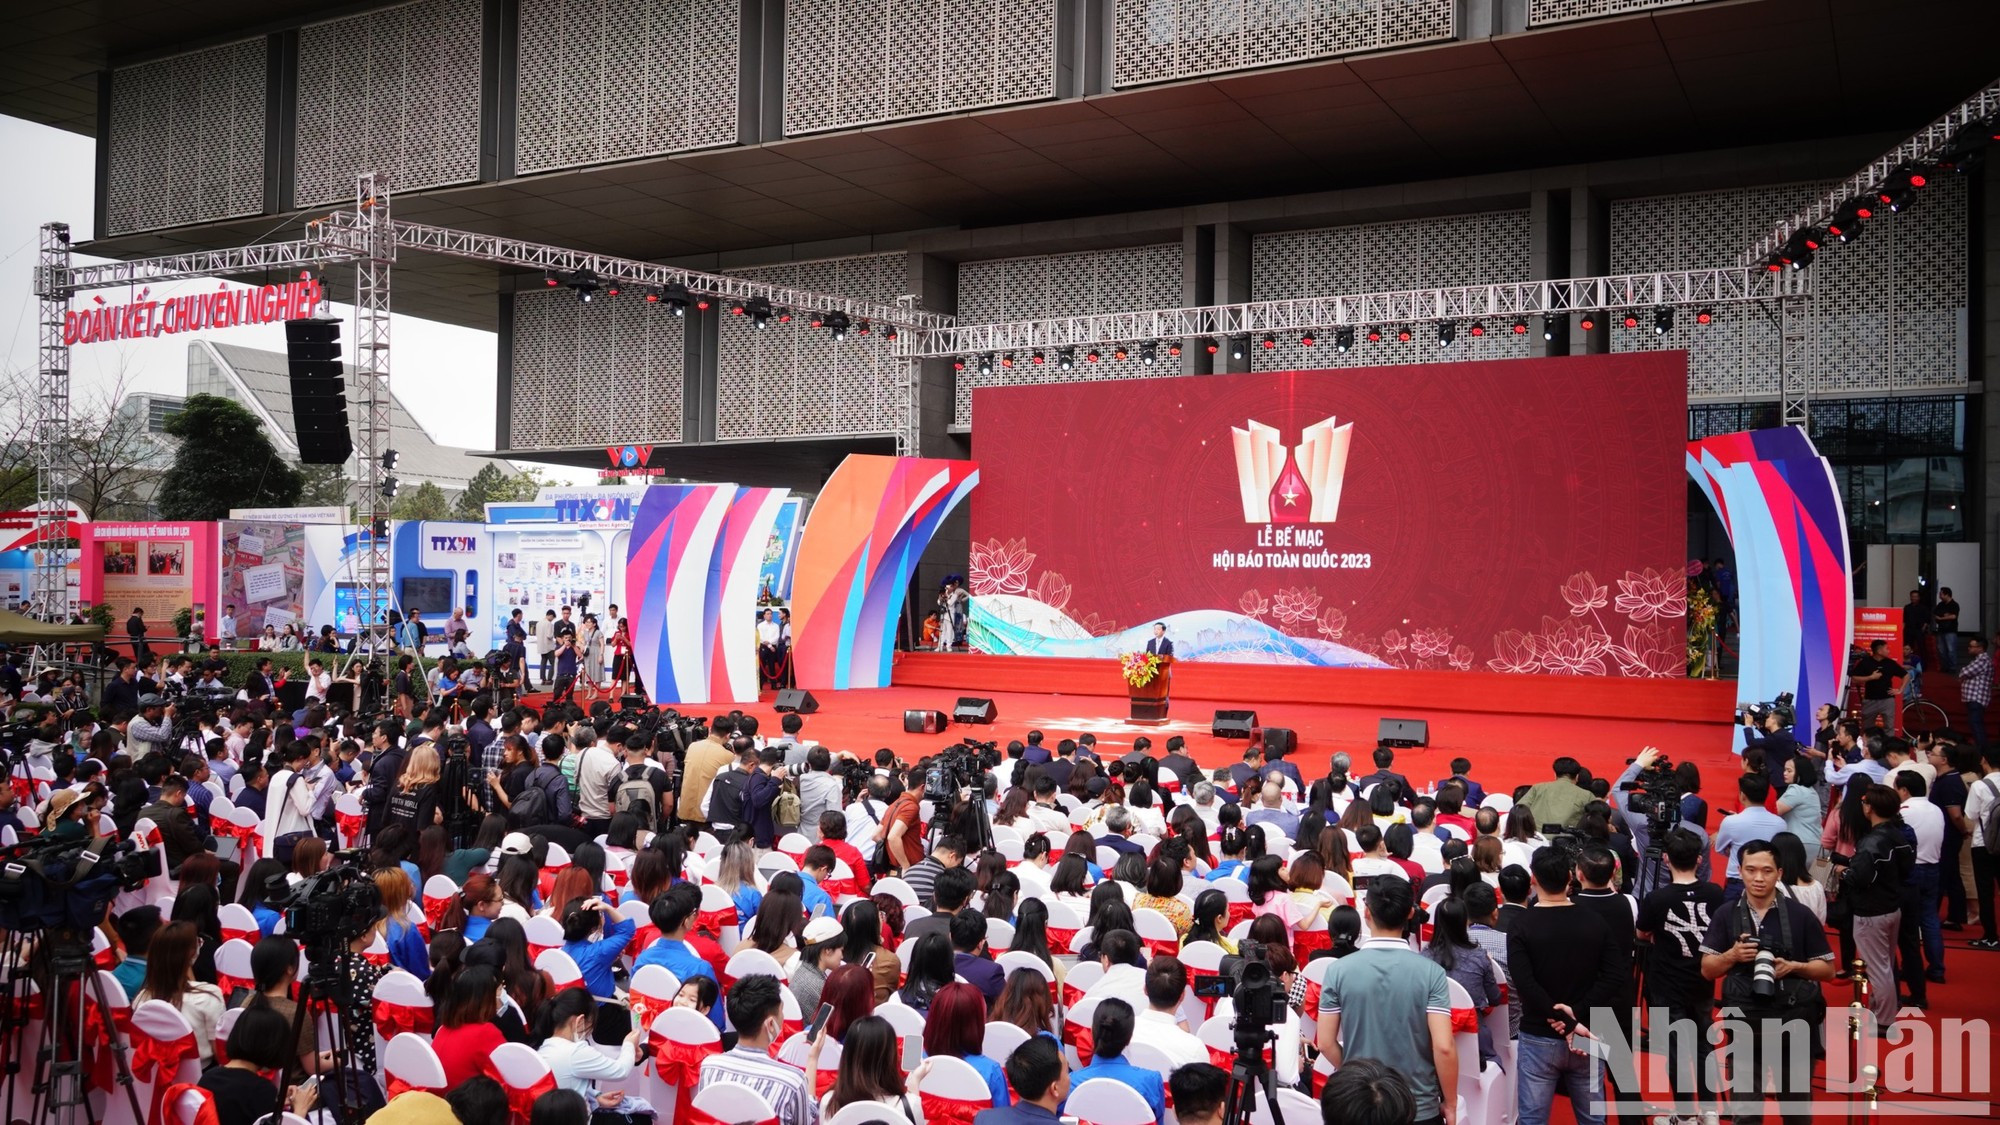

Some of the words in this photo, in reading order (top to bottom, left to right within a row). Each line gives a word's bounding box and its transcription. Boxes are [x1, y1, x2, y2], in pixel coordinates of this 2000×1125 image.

[64, 295, 119, 346] ĐOÀN
[163, 282, 242, 334] CHUYÊN
[607, 444, 654, 467] VOV
[648, 468, 666, 476] NAM
[555, 498, 631, 523] TTXVN
[431, 536, 476, 551] TTXVN
[1258, 523, 1273, 547] LỄ
[1275, 525, 1294, 547] BẾ
[1294, 529, 1324, 549] MẠC
[1212, 549, 1234, 572] HỘI
[1237, 549, 1264, 568] BÁO
[1266, 549, 1300, 568] TOÀN
[1302, 548, 1338, 568] QUỐC
[1340, 553, 1371, 568] 2023
